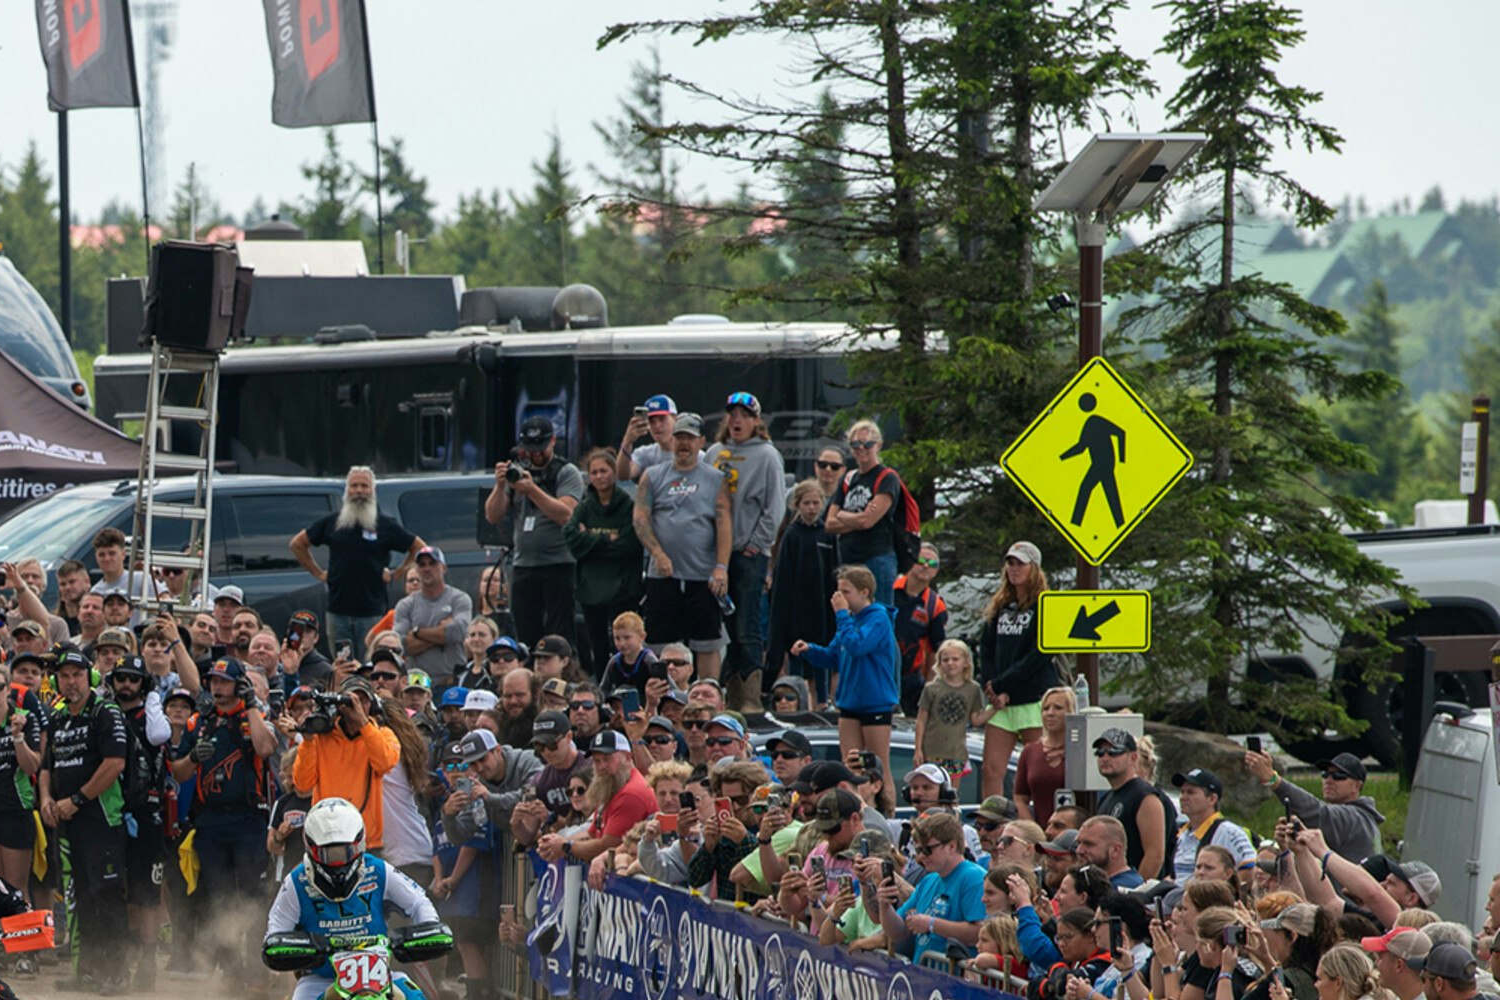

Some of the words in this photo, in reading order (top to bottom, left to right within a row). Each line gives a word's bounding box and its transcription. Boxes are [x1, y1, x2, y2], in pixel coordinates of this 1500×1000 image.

[319, 914, 373, 928] BABBITT'S
[339, 955, 388, 989] 314
[577, 962, 634, 993] RACING
